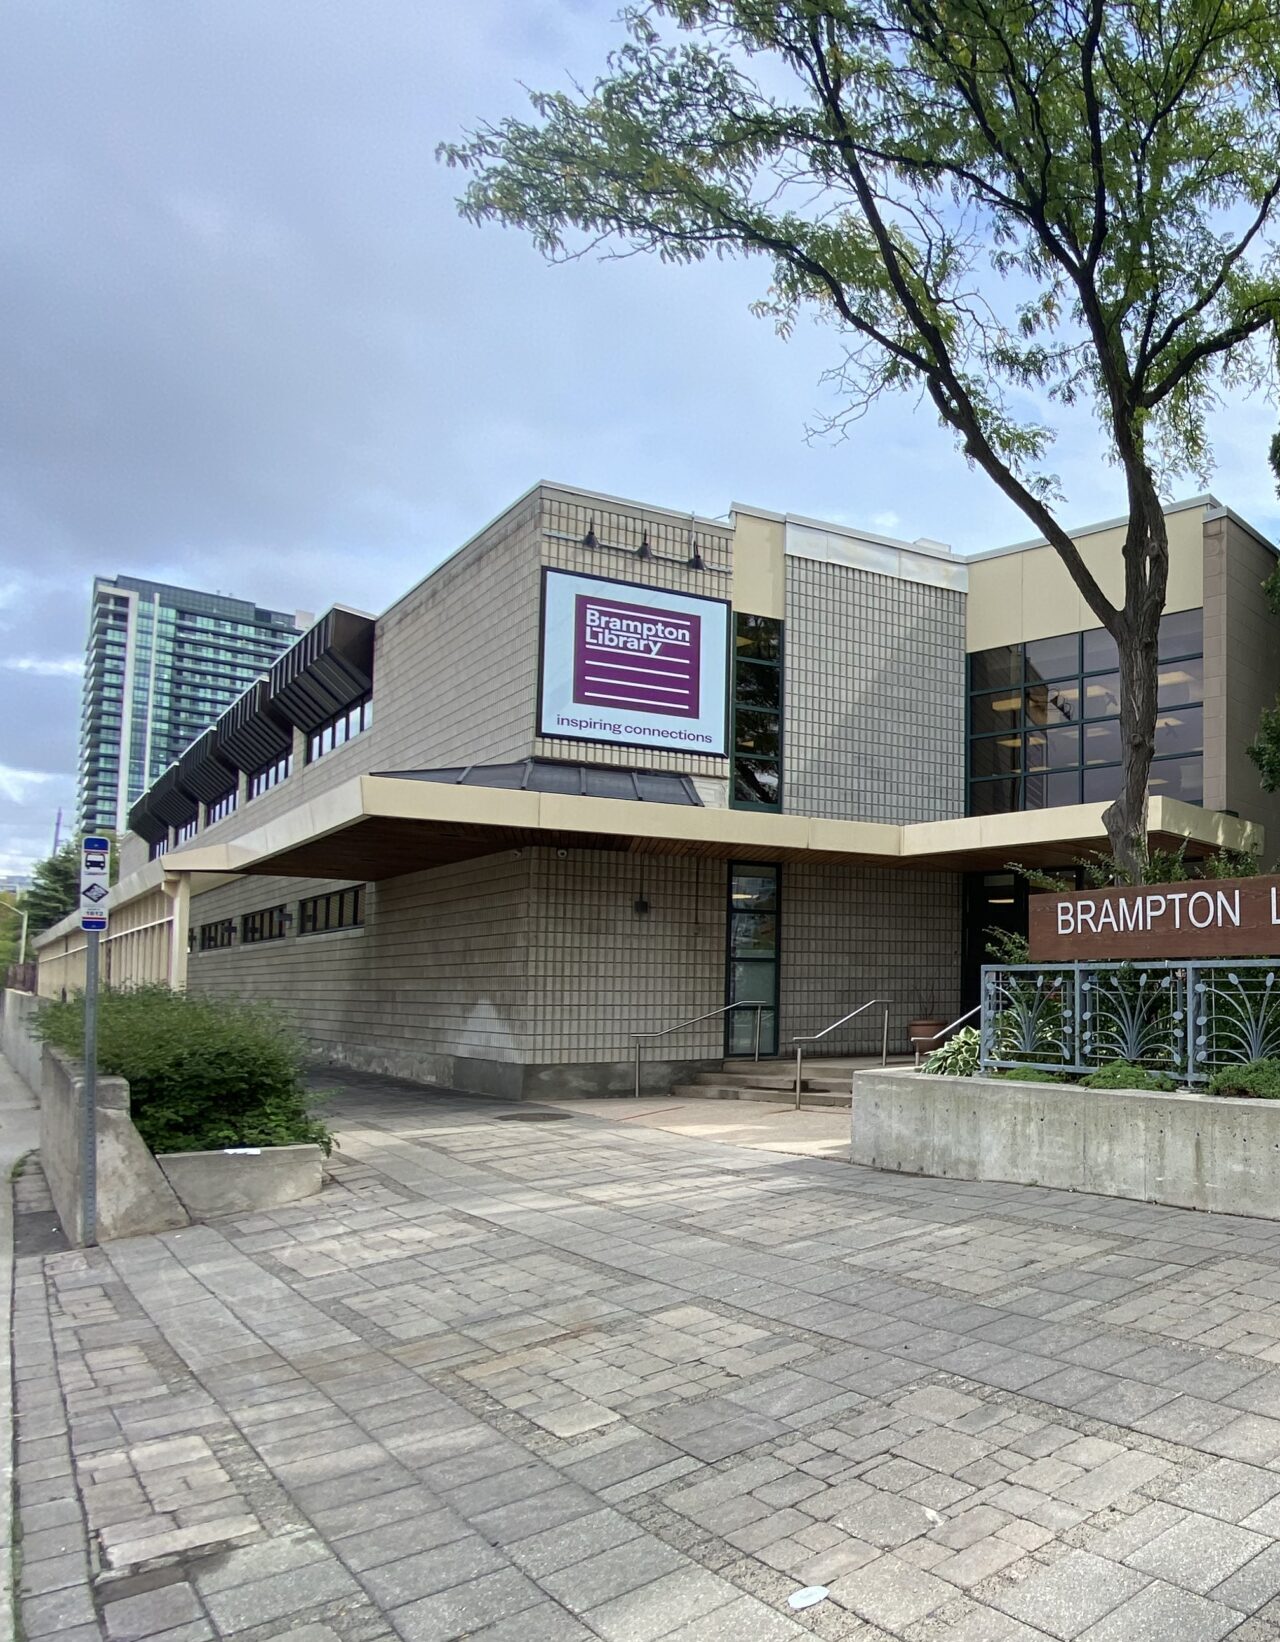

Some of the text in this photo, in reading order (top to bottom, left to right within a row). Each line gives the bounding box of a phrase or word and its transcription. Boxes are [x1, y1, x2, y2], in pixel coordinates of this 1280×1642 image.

[585, 625, 662, 656] Library
[586, 609, 690, 642] Brampton
[556, 714, 713, 743] inspiring connections
[1056, 889, 1241, 935] BRAMPTON
